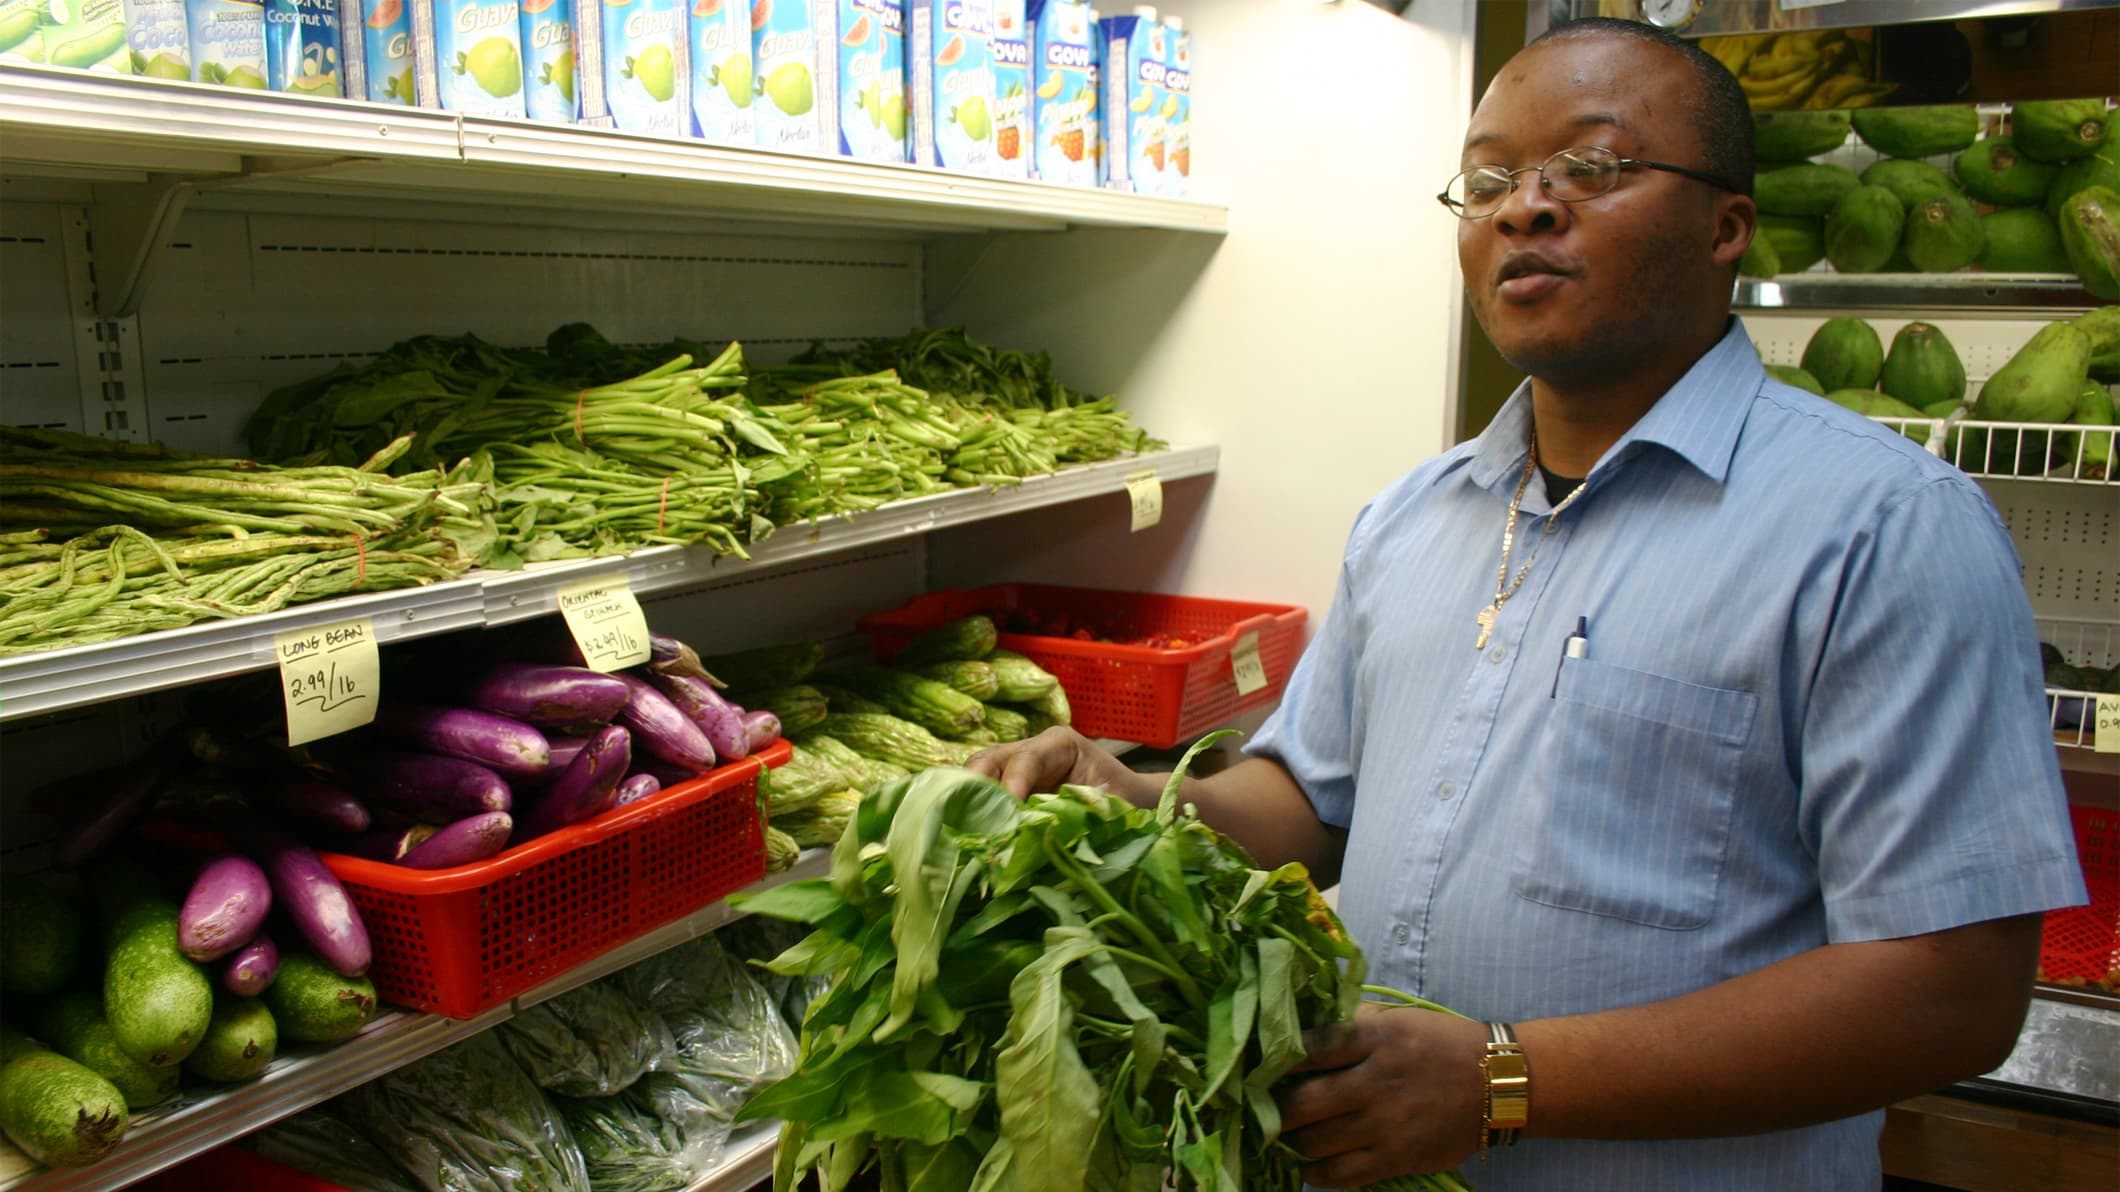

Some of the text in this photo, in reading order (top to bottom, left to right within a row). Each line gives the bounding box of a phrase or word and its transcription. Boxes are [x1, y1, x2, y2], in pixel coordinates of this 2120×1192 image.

[267, 10, 319, 26] Coconut
[282, 624, 364, 658] LONG BEAN
[291, 661, 356, 702] 2.99/lb
